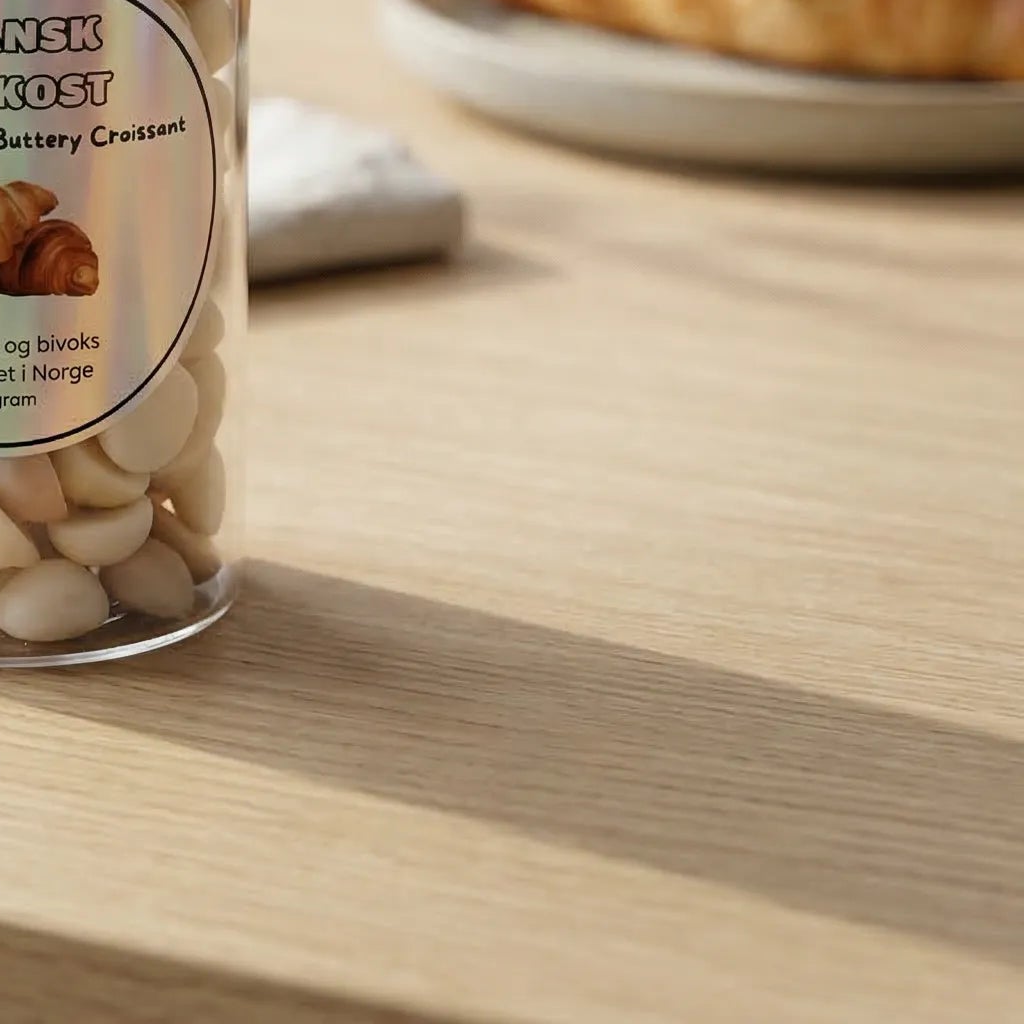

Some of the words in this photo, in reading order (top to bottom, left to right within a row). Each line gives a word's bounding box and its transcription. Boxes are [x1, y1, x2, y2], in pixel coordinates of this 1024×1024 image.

[90, 115, 187, 148] Croissant
[4, 340, 31, 359] og
[37, 332, 100, 353] bivoks
[21, 364, 27, 383] i
[32, 363, 94, 385] Norge
